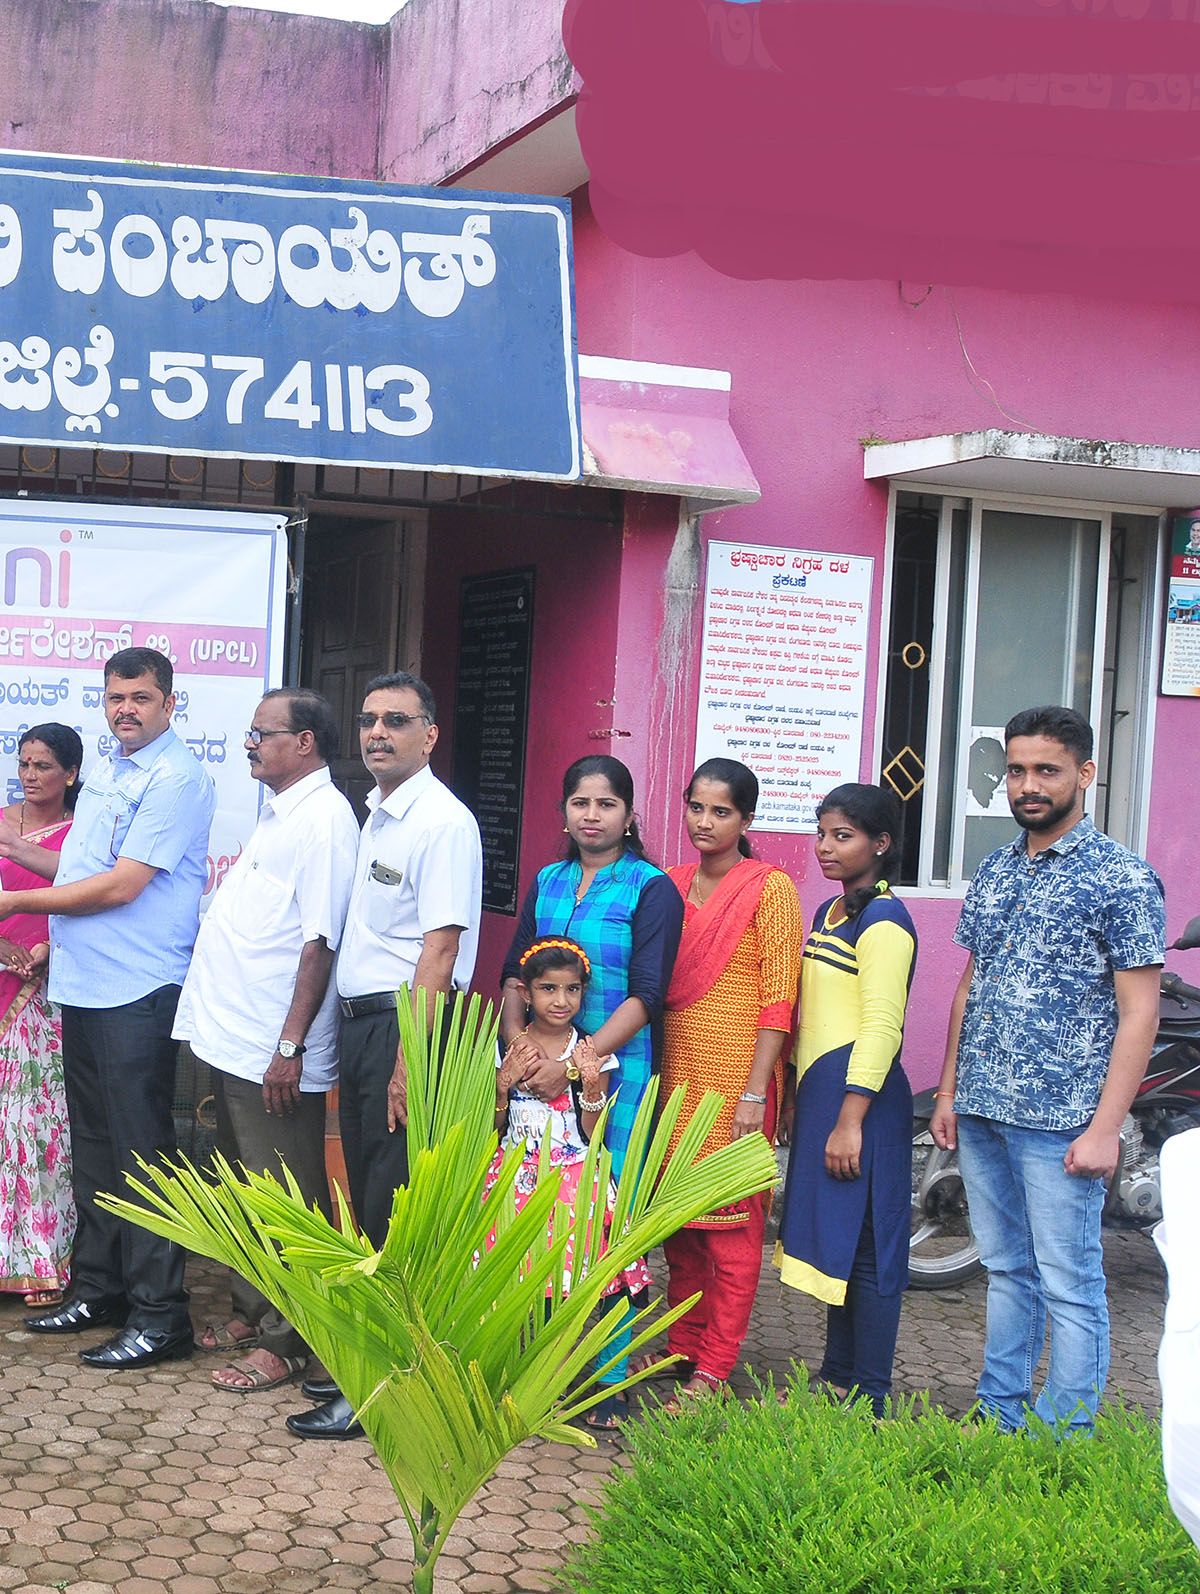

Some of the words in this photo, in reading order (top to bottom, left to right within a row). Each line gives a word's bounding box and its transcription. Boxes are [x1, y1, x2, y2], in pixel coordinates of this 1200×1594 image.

[52, 190, 496, 317] ಪಂಚಾಯತ್
[730, 548, 786, 571] ಭ್ರಷ್ಟಾಚಾರ
[792, 556, 823, 574] ನಿಗ್ರಹ
[829, 560, 849, 574] ದಳ
[772, 573, 807, 589] ಪ್ರಕಟಣೆ
[189, 637, 258, 667] (UPCL)
